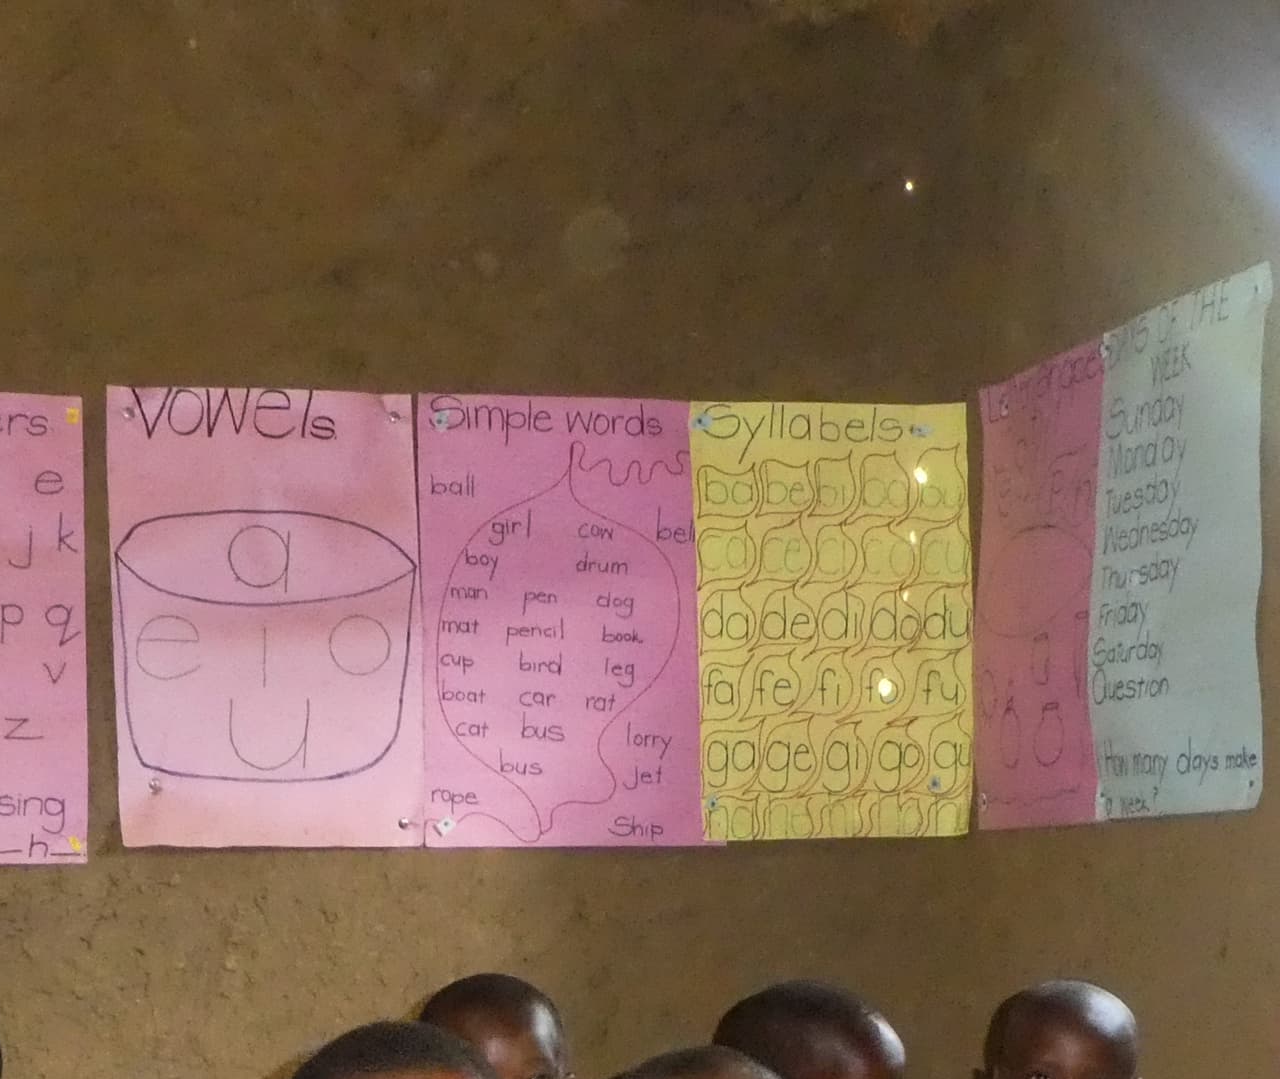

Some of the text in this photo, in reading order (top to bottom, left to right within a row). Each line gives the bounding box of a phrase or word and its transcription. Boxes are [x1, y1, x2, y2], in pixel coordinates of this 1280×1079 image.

[429, 395, 553, 446] Simple
[701, 404, 904, 464] Syllabels
[1106, 394, 1185, 440] Sunday
[1108, 435, 1186, 479] Monday
[34, 470, 65, 495] e
[430, 474, 475, 497] ball
[1105, 470, 1182, 522] Tuesday
[57, 512, 78, 552] k
[488, 508, 532, 546] girl
[577, 521, 614, 540] cow
[1102, 515, 1198, 554] Wednesday
[464, 547, 629, 581] boy drum
[1101, 556, 1180, 594] Thursday
[450, 585, 635, 618] man pen dog
[761, 594, 814, 641] de
[871, 591, 919, 642] do
[1098, 592, 1149, 640] Friday
[440, 618, 480, 635] mat
[506, 617, 565, 646] pencil
[1091, 632, 1164, 669] Saturday
[43, 661, 67, 684] v
[440, 651, 635, 688] cup bird leg
[704, 668, 734, 706] fa
[756, 669, 795, 707] fe
[440, 680, 617, 712] boat car rat
[455, 712, 672, 760] cat bus lorry
[499, 748, 544, 776] bus
[707, 740, 756, 788] ga
[758, 740, 813, 793] ge
[873, 740, 921, 793] go
[1176, 736, 1219, 786] days
[1225, 745, 1257, 769] make
[431, 788, 479, 815] rope
[607, 815, 665, 840] Ship
